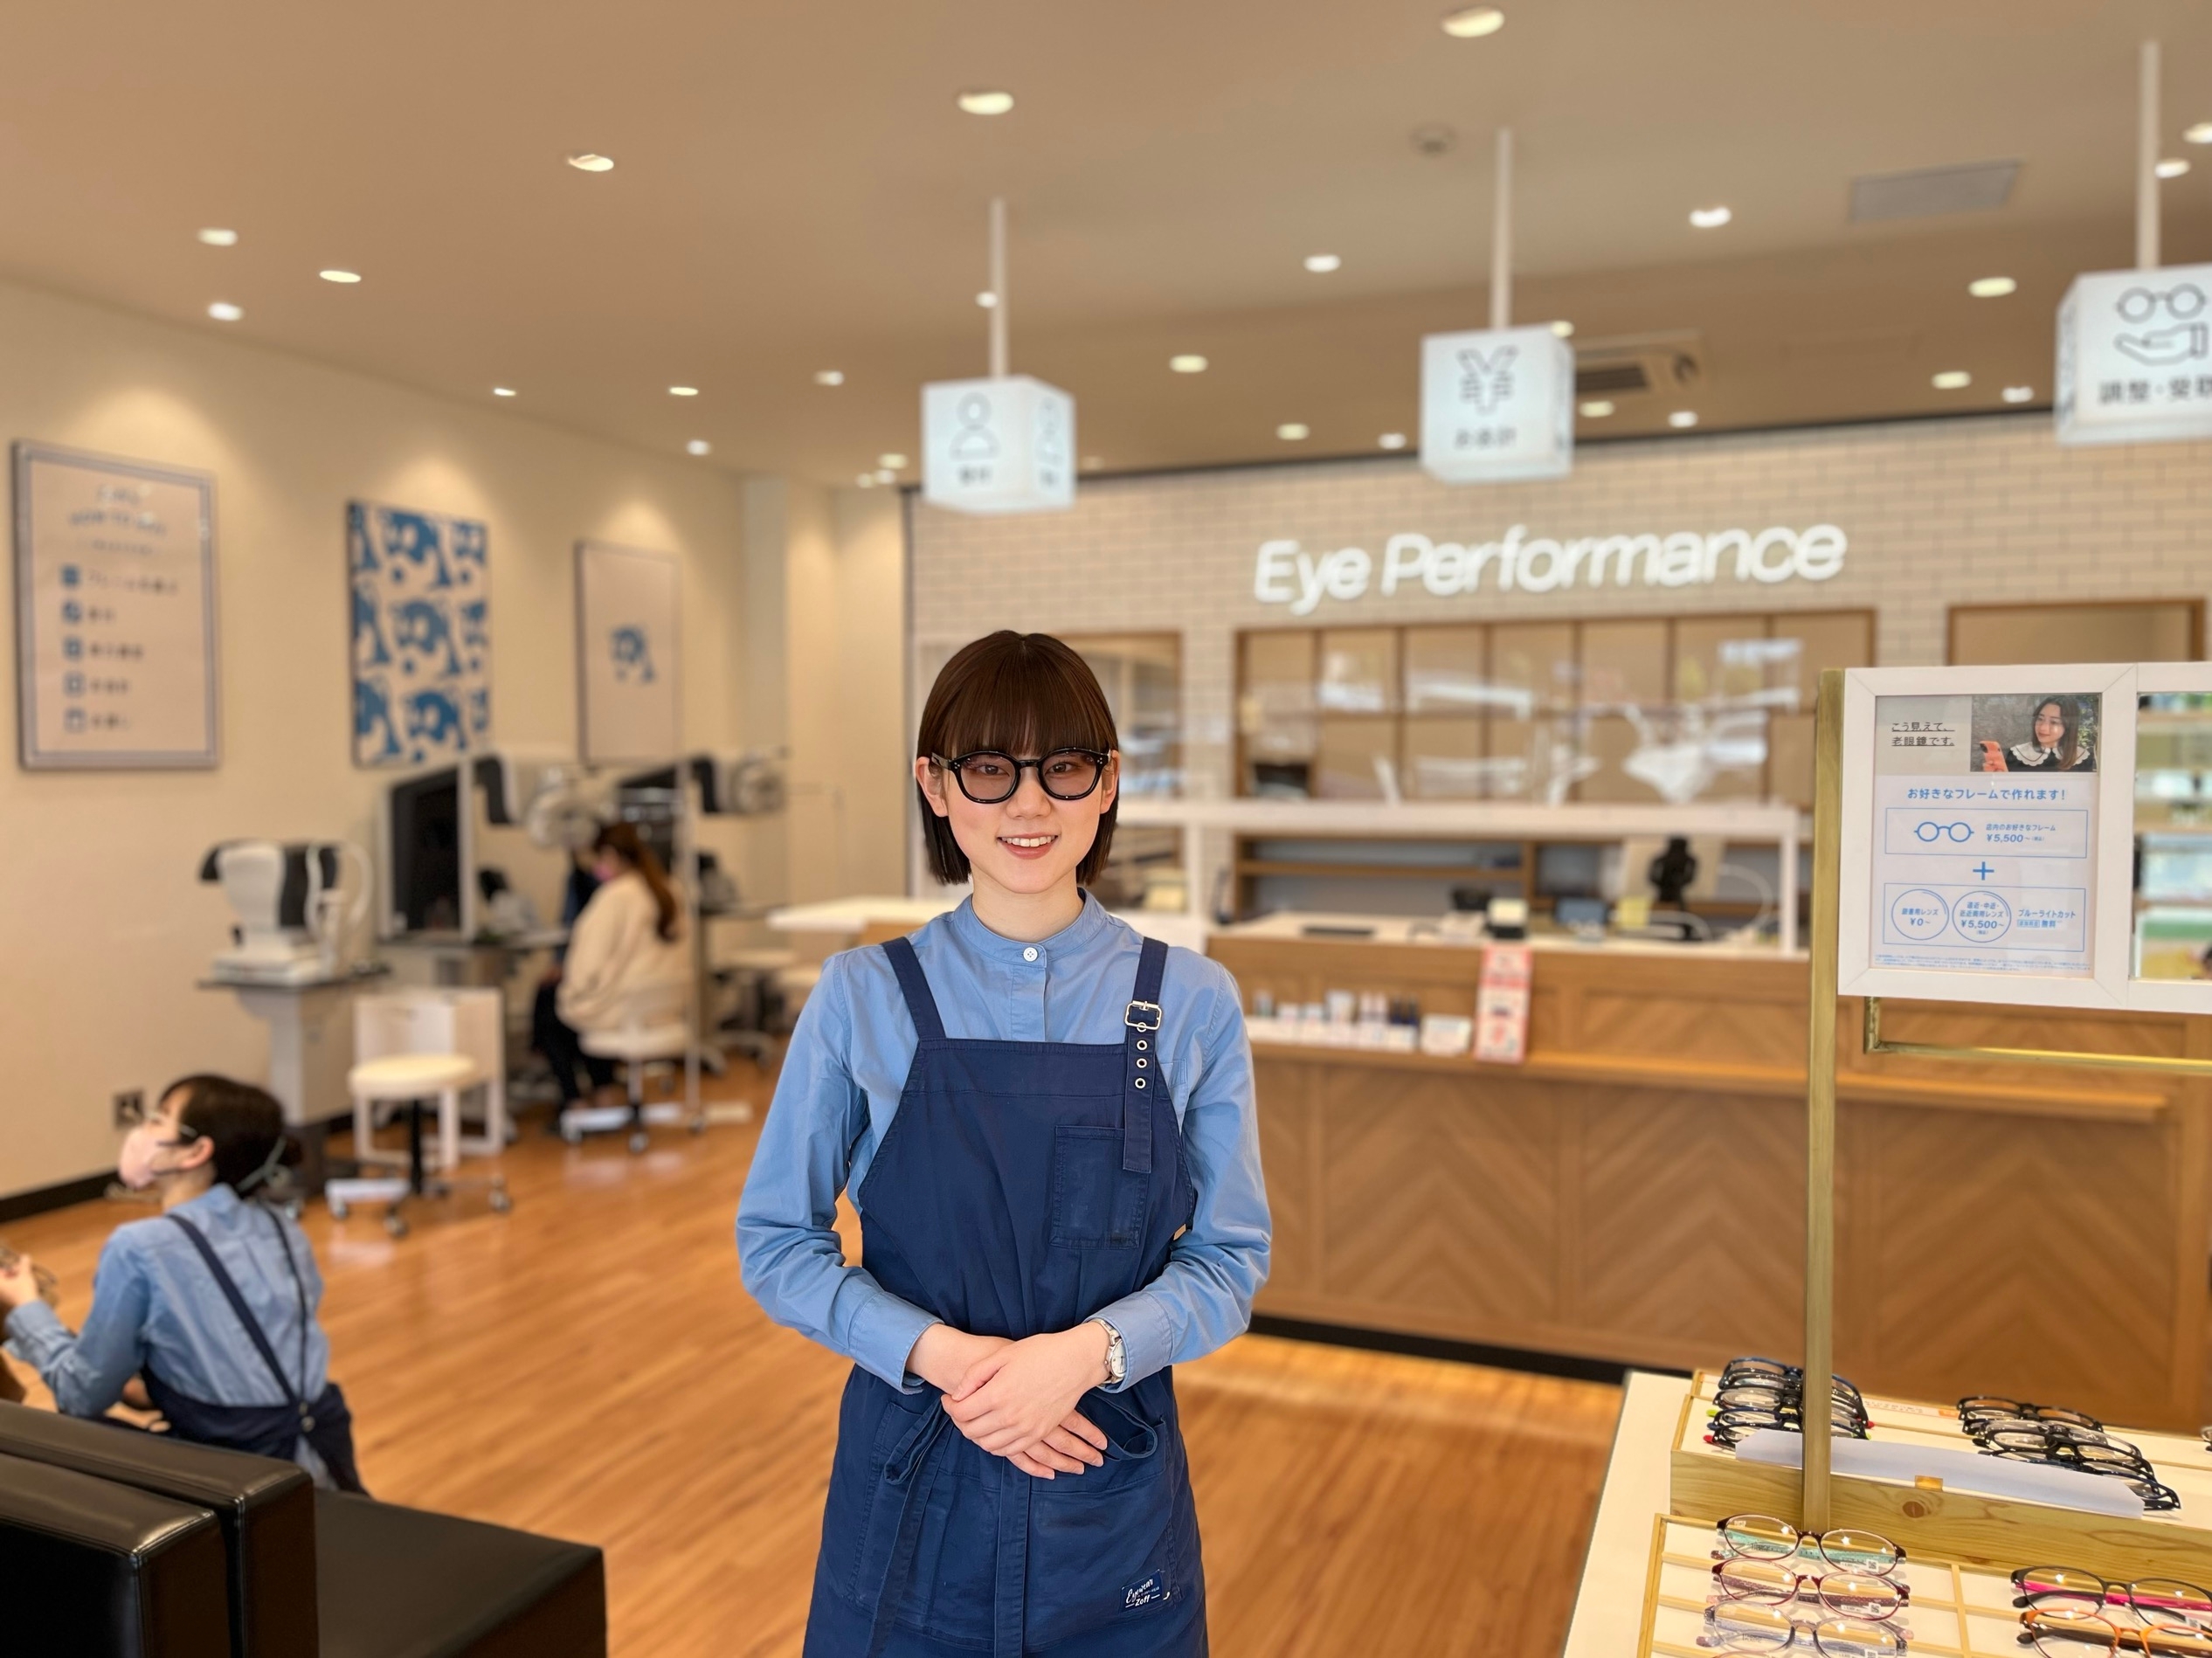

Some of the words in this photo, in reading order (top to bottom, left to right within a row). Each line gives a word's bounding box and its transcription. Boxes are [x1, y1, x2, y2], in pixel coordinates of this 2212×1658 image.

[1254, 539, 1372, 615] Eye
[1380, 524, 1848, 599] Performance
[1891, 722, 1948, 732] こう見えて、
[1891, 736, 1955, 747] 老眼鏡です。
